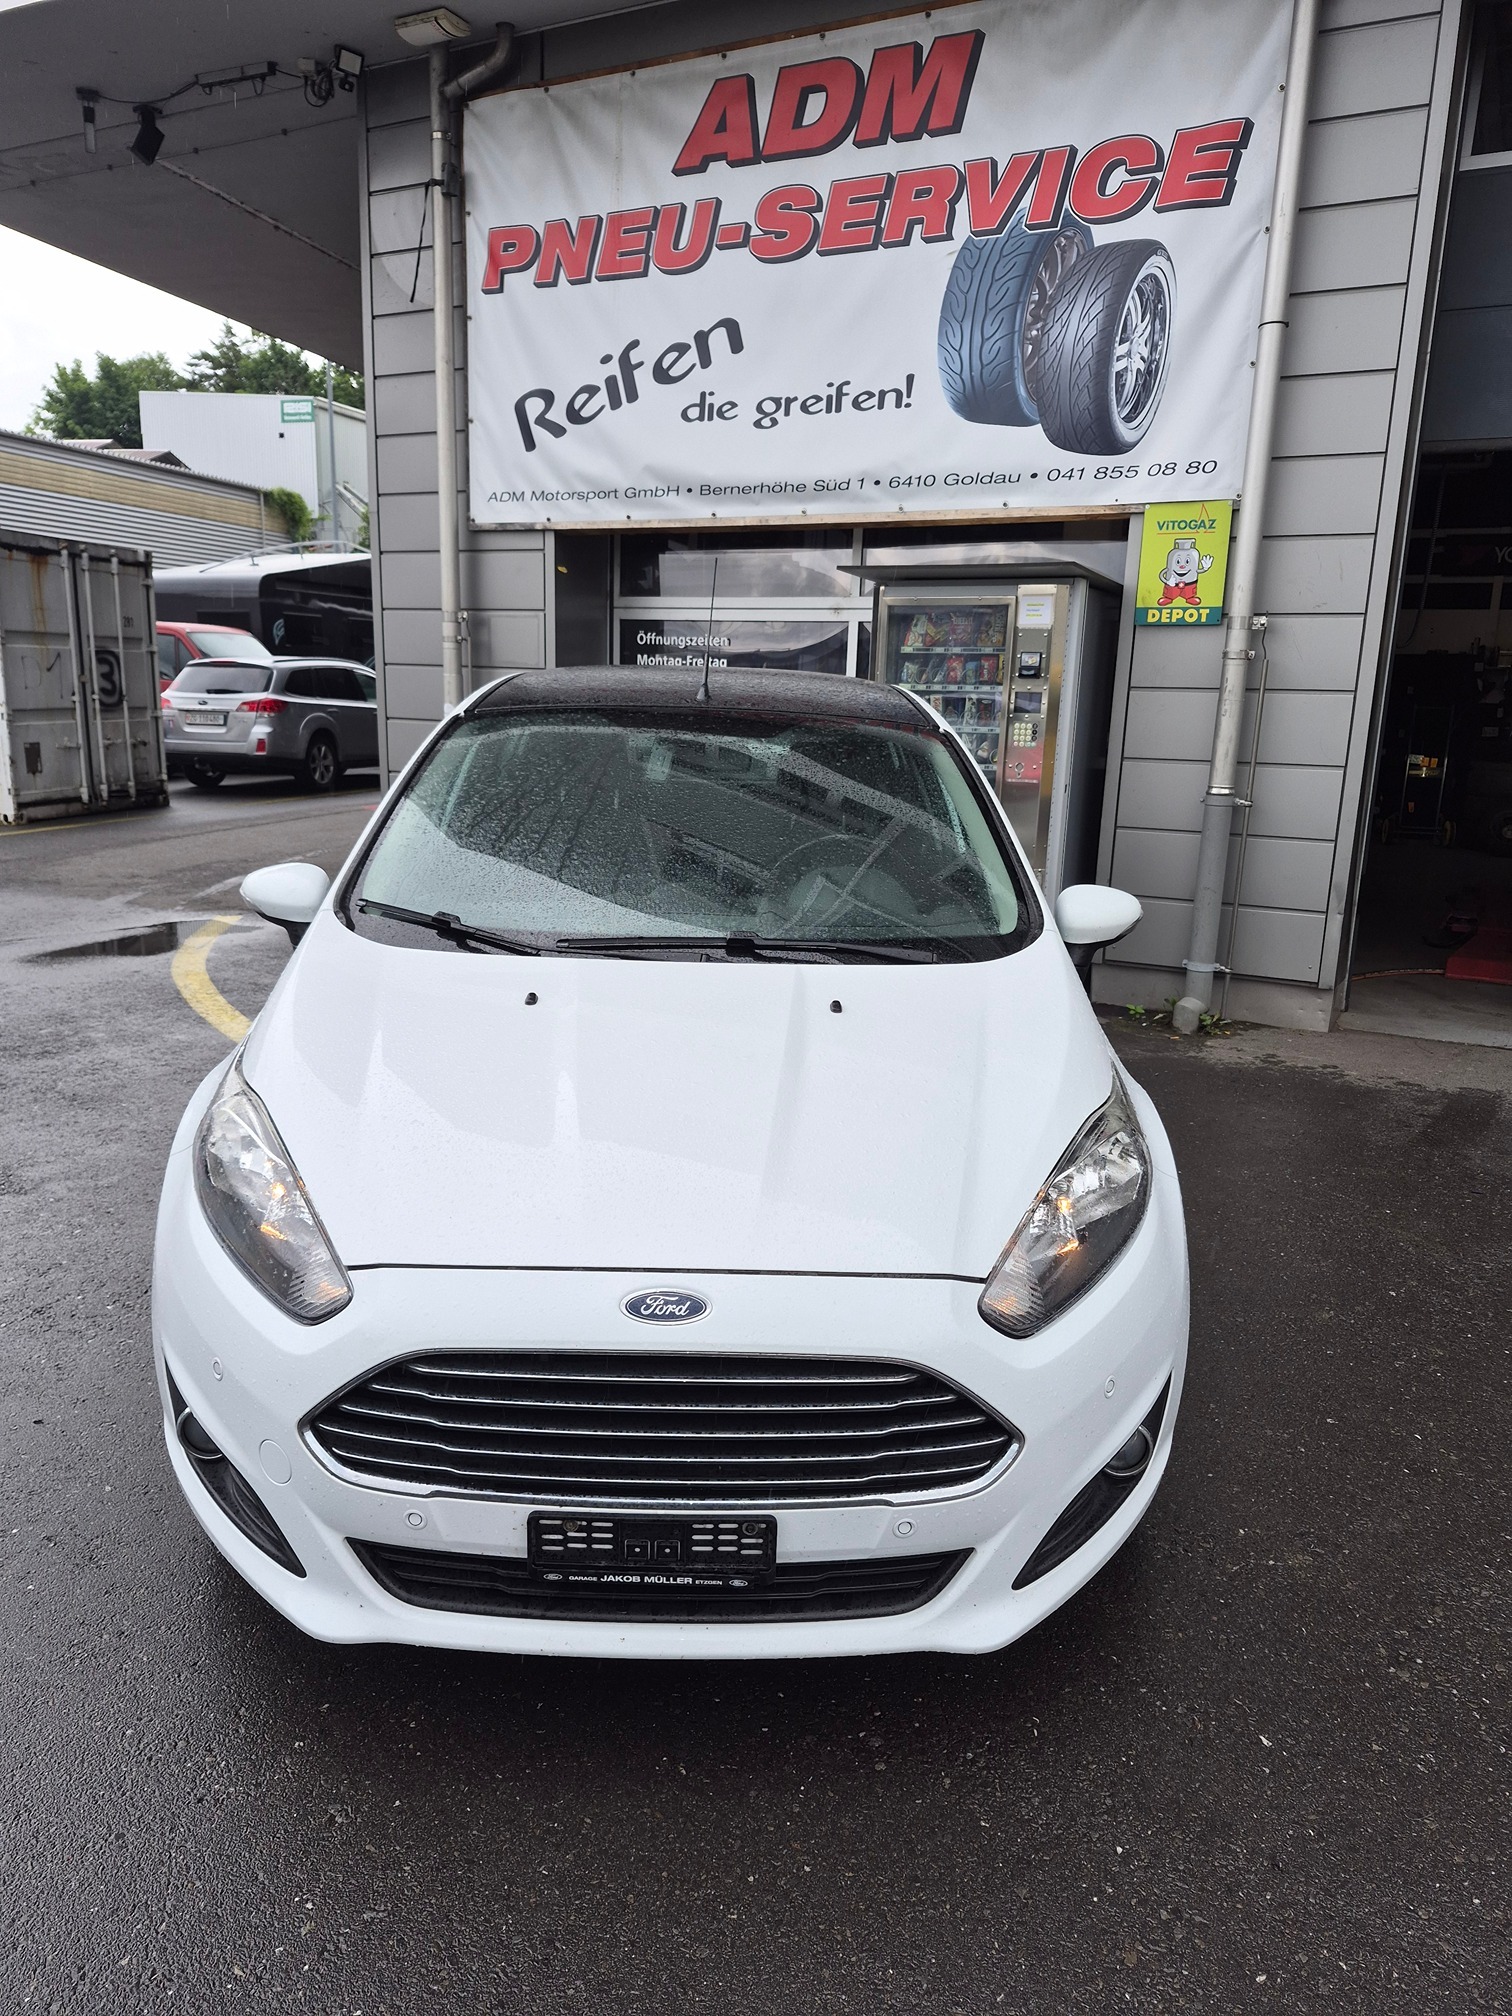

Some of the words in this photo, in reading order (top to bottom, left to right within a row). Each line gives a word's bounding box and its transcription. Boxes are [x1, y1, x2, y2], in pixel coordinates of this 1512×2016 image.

[671, 29, 986, 177] ADM
[481, 117, 1254, 294] PNEU-SERVICE
[514, 317, 744, 452] Reifen
[680, 390, 739, 423] die
[753, 373, 915, 429] greifen!
[487, 491, 526, 503] ADM
[530, 488, 619, 502] Motorsport
[624, 485, 681, 499] GmbH
[699, 481, 807, 496] Bernerhöhe
[813, 478, 852, 493] Süd
[857, 478, 866, 490] 1
[888, 474, 937, 489] 6410
[943, 471, 1021, 487] Goldau
[1046, 467, 1085, 482] 041
[1093, 465, 1139, 480] 855
[1147, 462, 1178, 477] 08
[1185, 459, 1218, 475] 80
[1147, 608, 1210, 623] DEPOT
[636, 630, 730, 649] Öffnungszeiten
[636, 653, 728, 668] Montag-Fretag
[640, 1295, 691, 1316] Ford
[600, 1574, 641, 1583] JAKOB
[644, 1575, 693, 1585] MÜLLER
